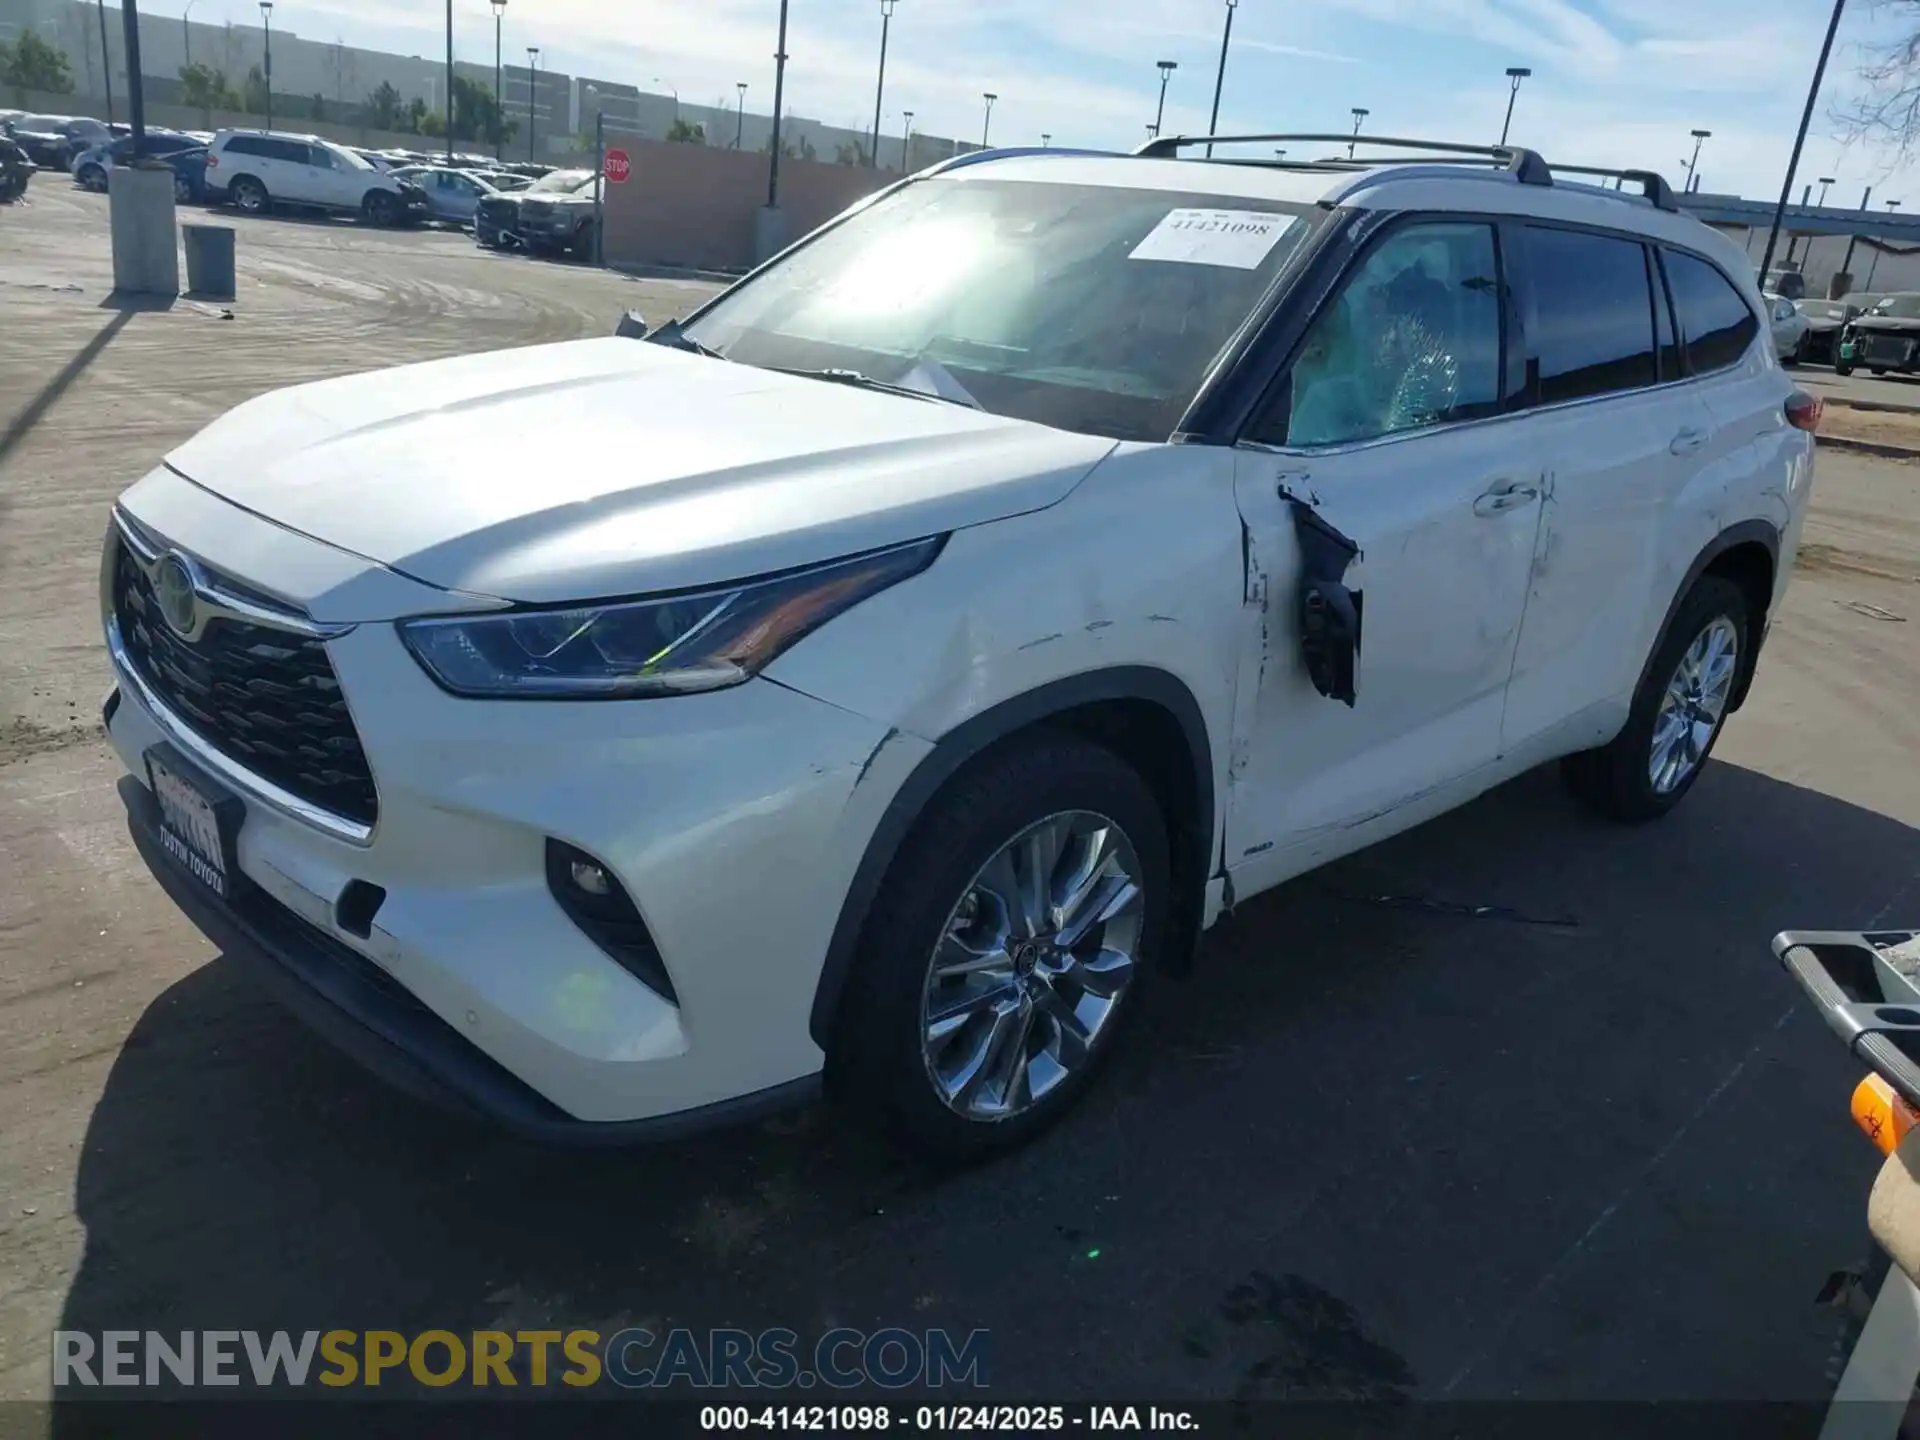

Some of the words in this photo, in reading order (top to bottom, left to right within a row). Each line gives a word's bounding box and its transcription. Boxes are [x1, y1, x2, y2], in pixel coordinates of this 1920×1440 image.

[606, 158, 630, 172] STOP
[1170, 220, 1271, 235] 41421098
[160, 824, 189, 865] TUSTIN
[189, 851, 224, 896] TOYOTA
